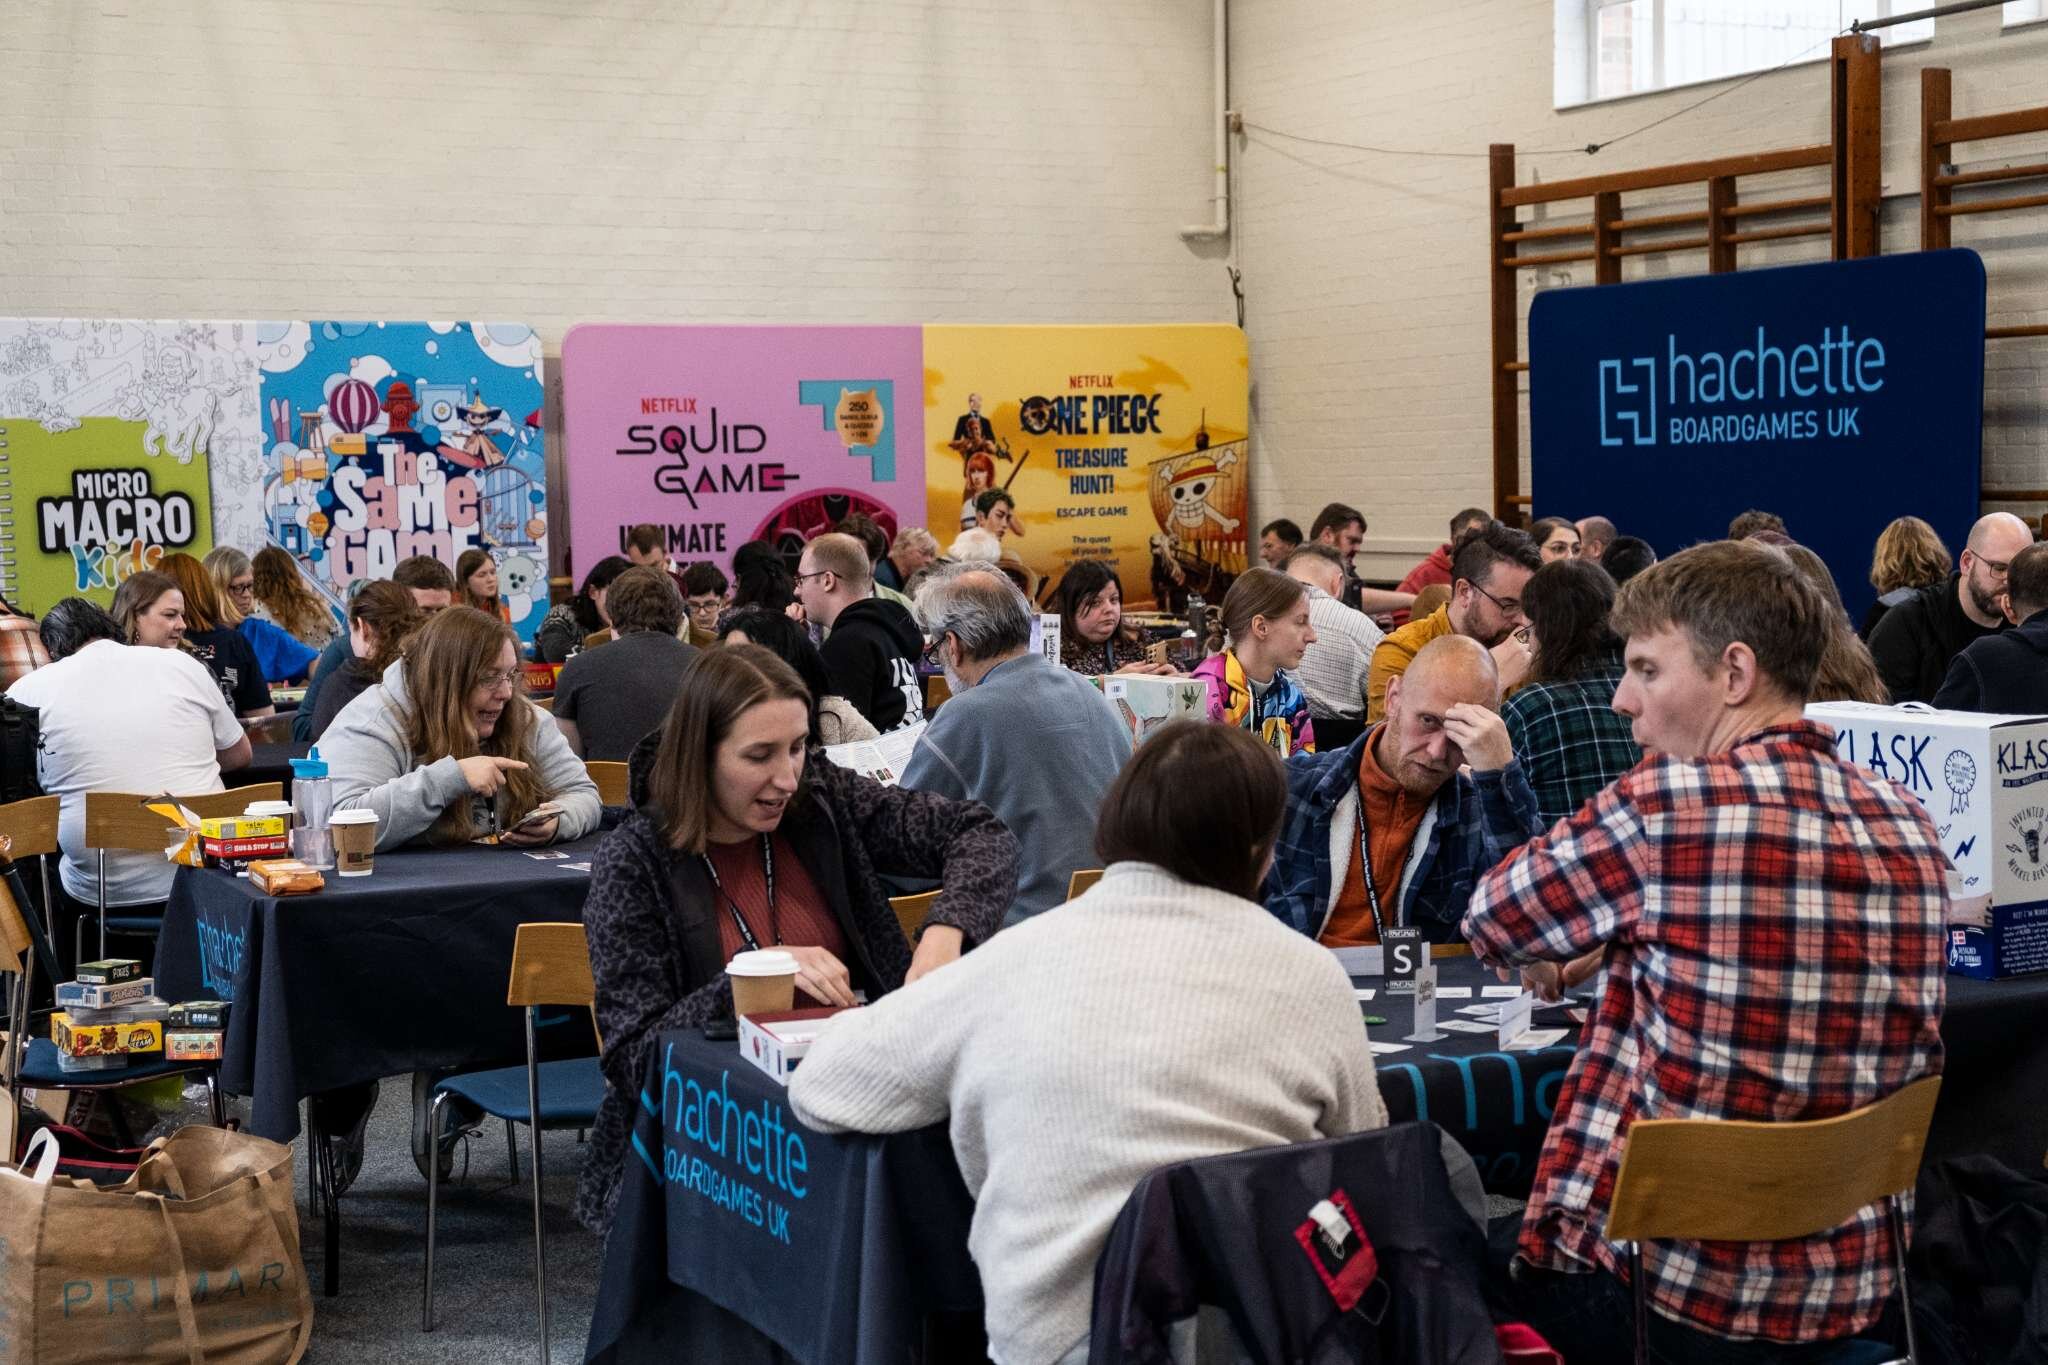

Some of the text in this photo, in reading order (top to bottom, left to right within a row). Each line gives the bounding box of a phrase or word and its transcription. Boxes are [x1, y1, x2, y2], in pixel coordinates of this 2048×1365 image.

[1669, 325, 1886, 404] hachette
[1069, 375, 1114, 389] NETFLIX
[641, 398, 697, 414] NETFLIX
[848, 401, 869, 412] 250
[1020, 393, 1163, 435] ONE PIECE
[616, 407, 766, 462] SQUID
[1670, 407, 1860, 444] BOARDGAMES UK
[376, 442, 438, 486] The
[1055, 448, 1128, 468] TREASURE
[76, 471, 149, 499] MICRO
[654, 463, 800, 510] GAME
[1069, 474, 1115, 495] HUNT!
[42, 496, 192, 549] MACRO
[1056, 506, 1128, 518] ESCAPE GAME
[619, 523, 727, 554] UIMATE
[1072, 536, 1087, 544] The
[1393, 944, 1412, 974] S
[662, 1042, 808, 1199] hachette
[663, 1144, 791, 1245] OARDGAMES UK
